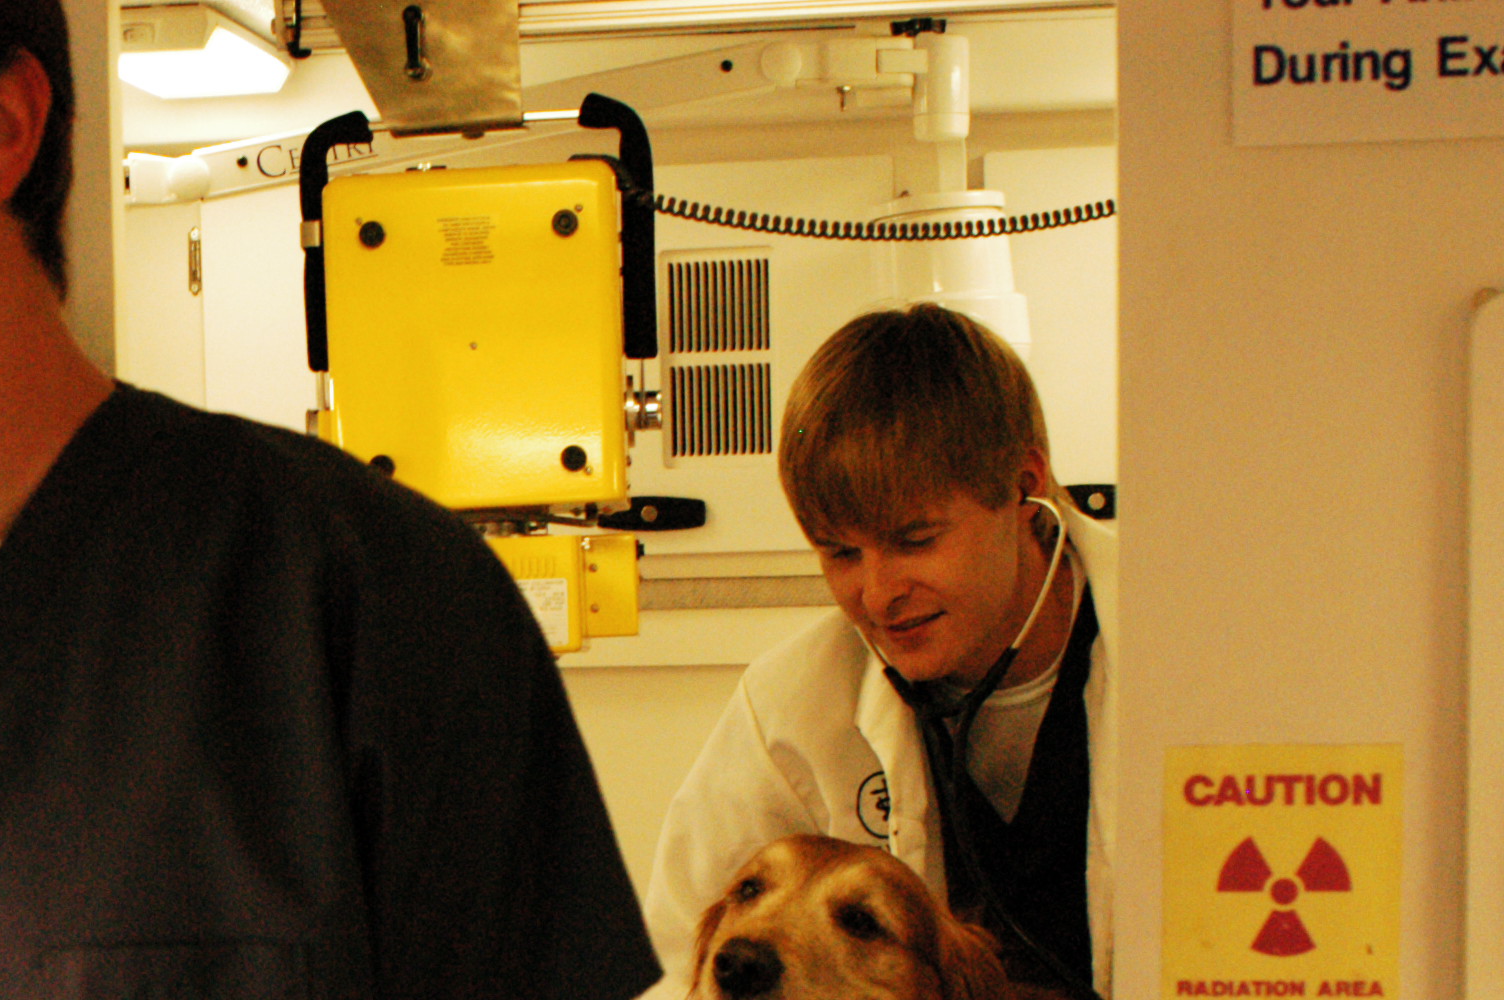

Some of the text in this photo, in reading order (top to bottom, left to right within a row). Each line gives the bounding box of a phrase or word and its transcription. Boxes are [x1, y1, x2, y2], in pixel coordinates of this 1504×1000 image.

[1252, 35, 1504, 90] During Ex
[1183, 773, 1383, 807] CAUTION
[1176, 980, 1385, 997] RADIATION AREA
